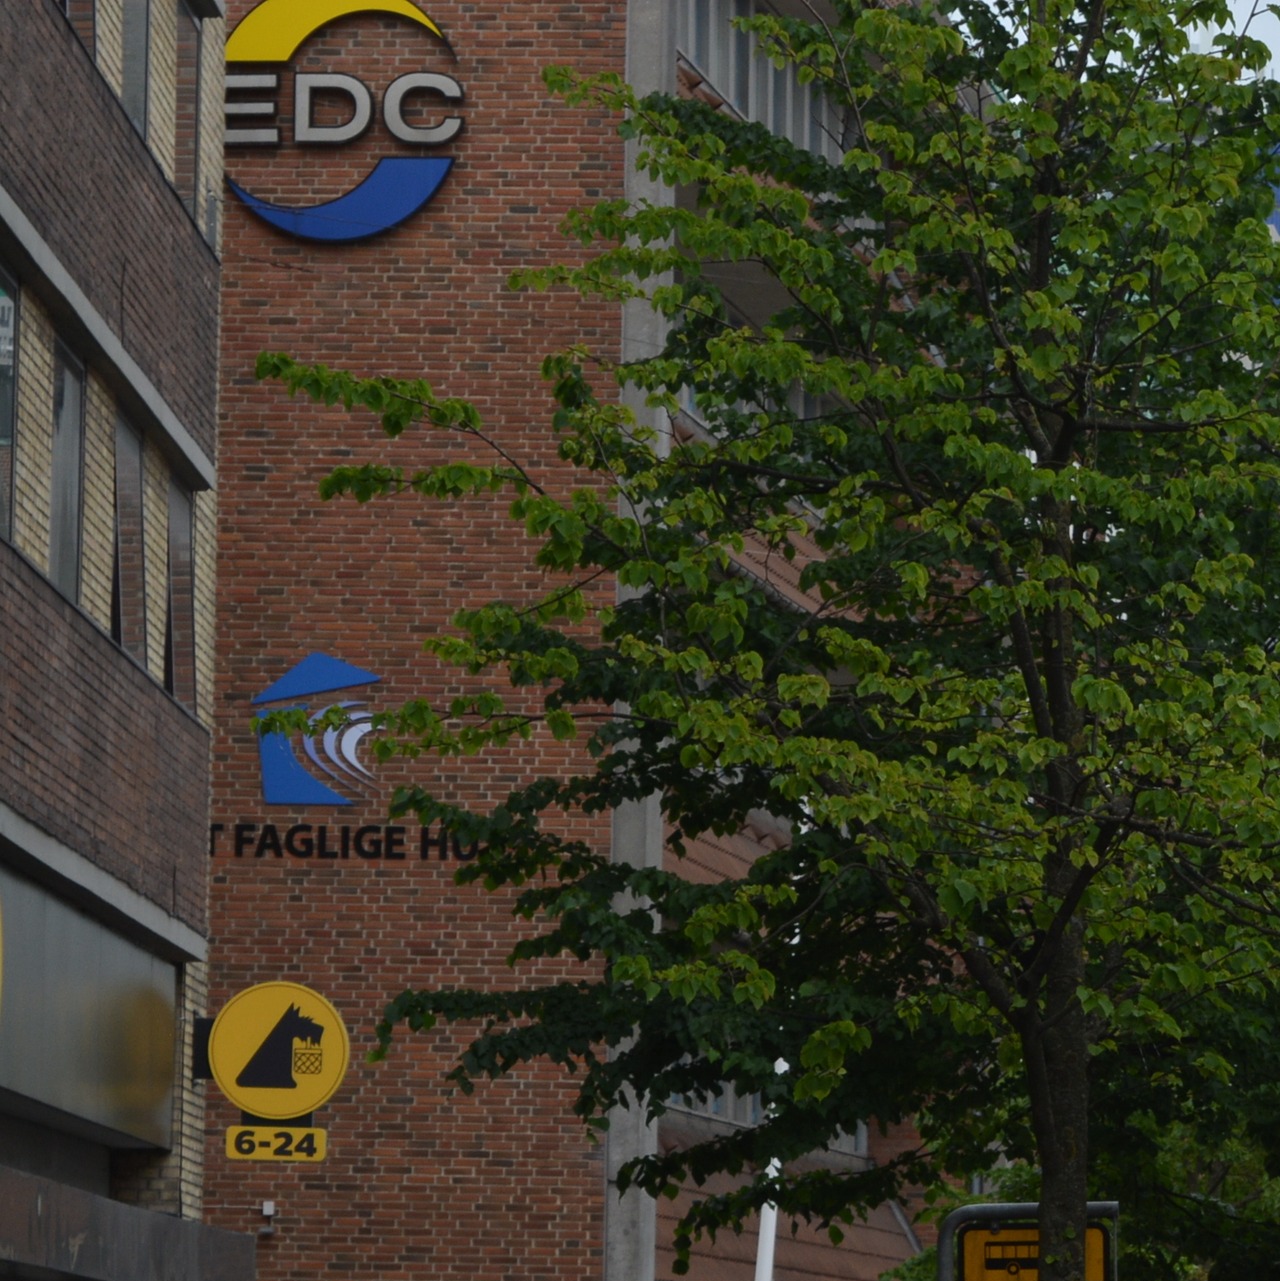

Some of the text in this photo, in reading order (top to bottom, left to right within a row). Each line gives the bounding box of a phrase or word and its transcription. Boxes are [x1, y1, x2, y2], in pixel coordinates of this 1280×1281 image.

[224, 71, 466, 147] EDC
[234, 824, 406, 860] FAGLIGE
[234, 1130, 317, 1158] 6-24
